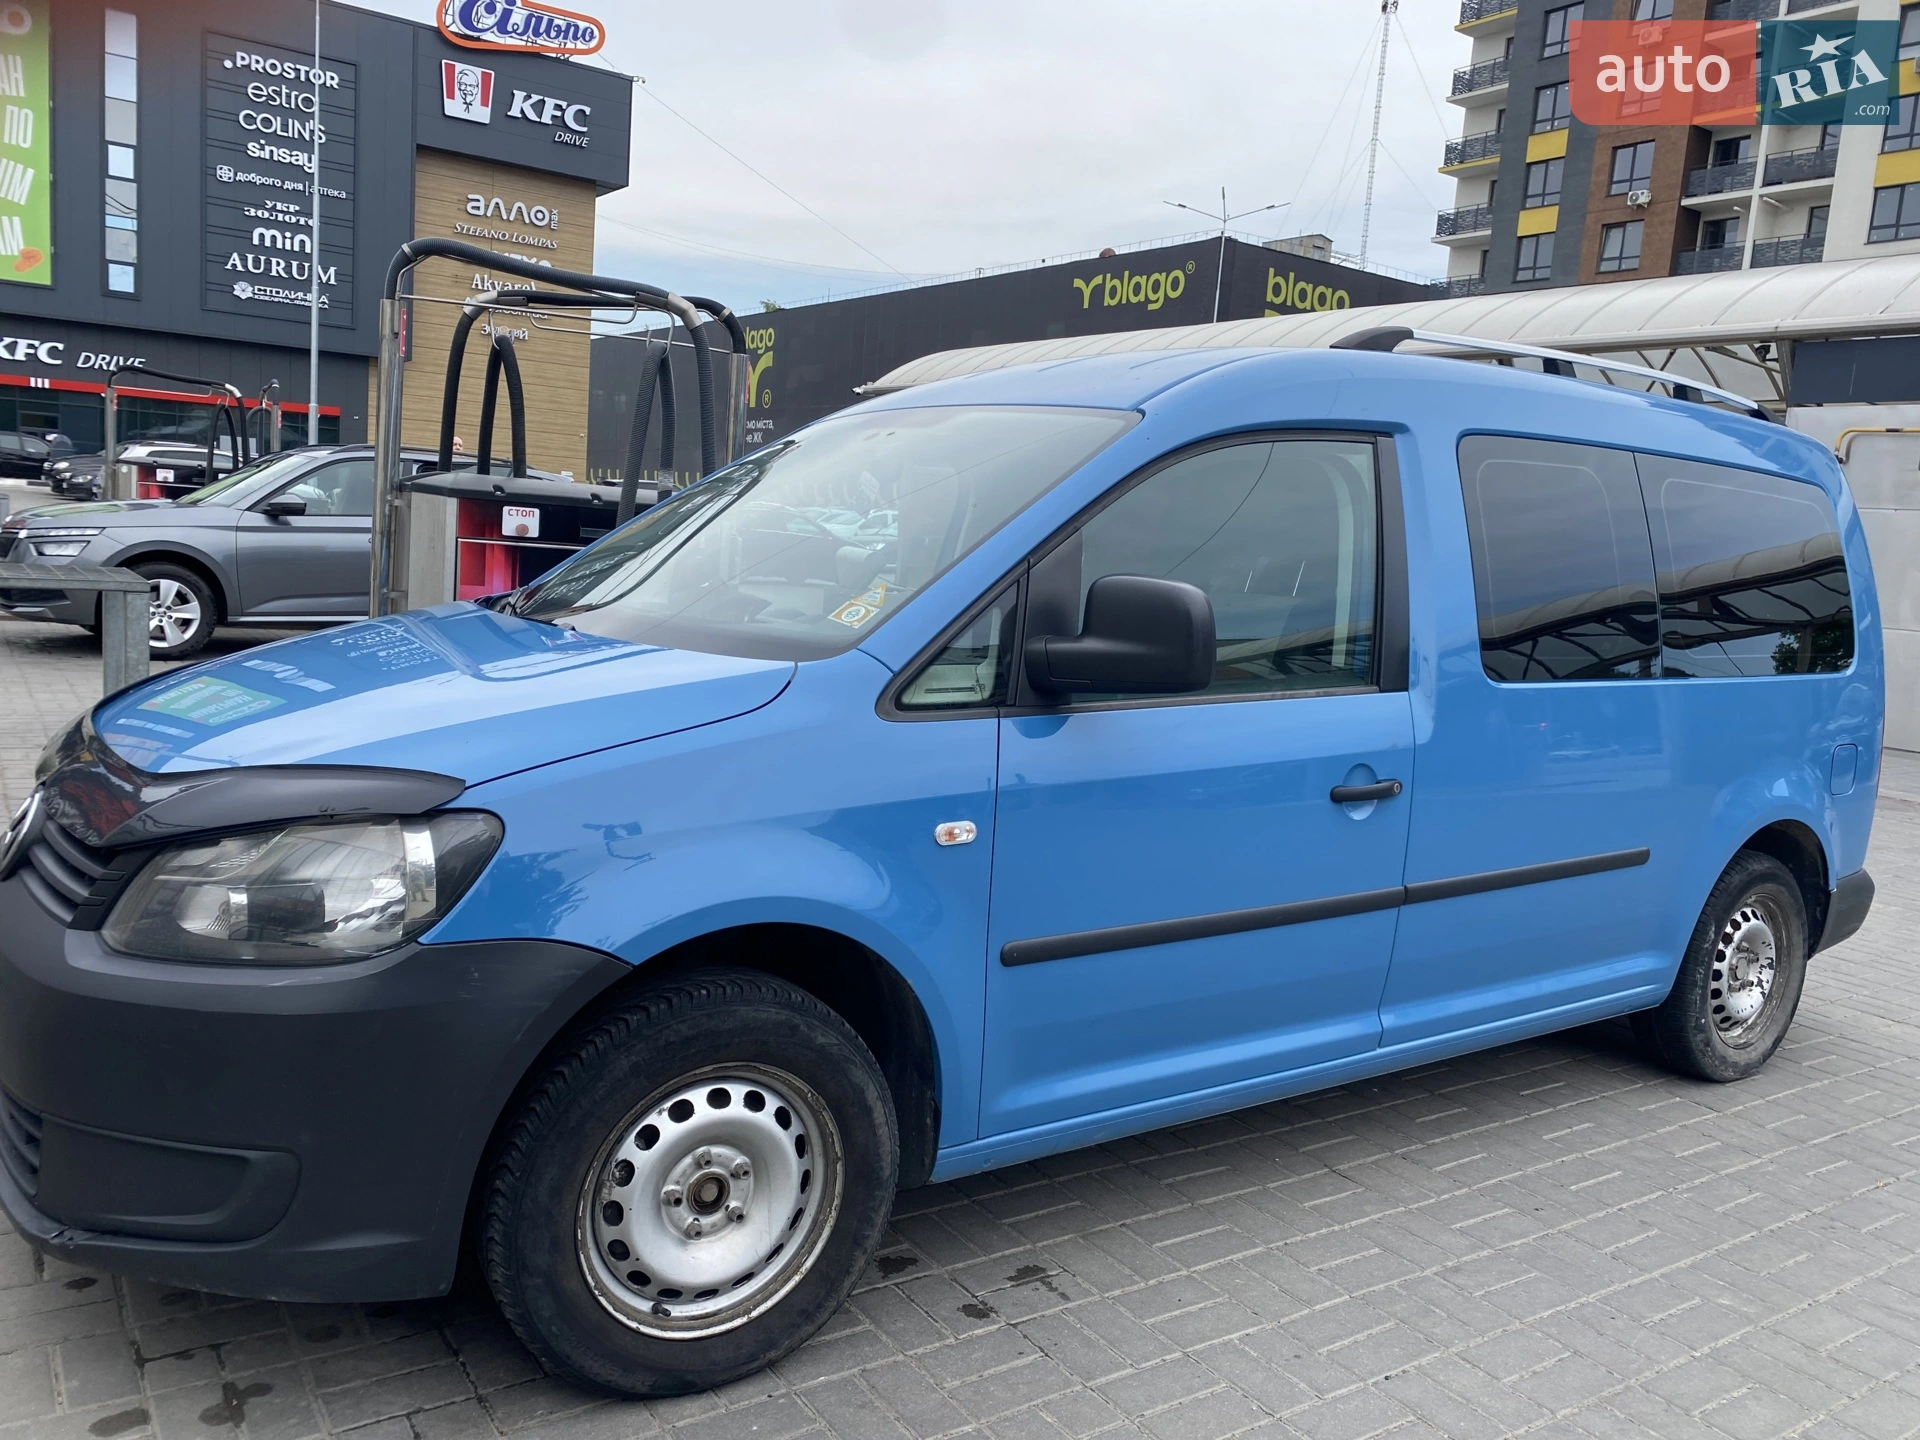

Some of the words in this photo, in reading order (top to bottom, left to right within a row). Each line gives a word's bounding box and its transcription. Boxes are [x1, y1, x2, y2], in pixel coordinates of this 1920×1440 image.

[247, 82, 317, 113] estro
[506, 89, 591, 133] KFC
[238, 109, 326, 144] COLIN'S
[554, 131, 590, 148] DRIVE
[247, 139, 315, 174] sinsay
[235, 171, 282, 187] доброго
[283, 180, 304, 191] дня
[264, 199, 300, 213] УКР
[454, 222, 509, 241] STEFANO
[512, 232, 558, 249] LOMPAS
[224, 252, 337, 285] AURUM
[254, 285, 329, 304] СТОЛИЧА
[744, 326, 775, 355] lago
[507, 508, 535, 518] СТОП
